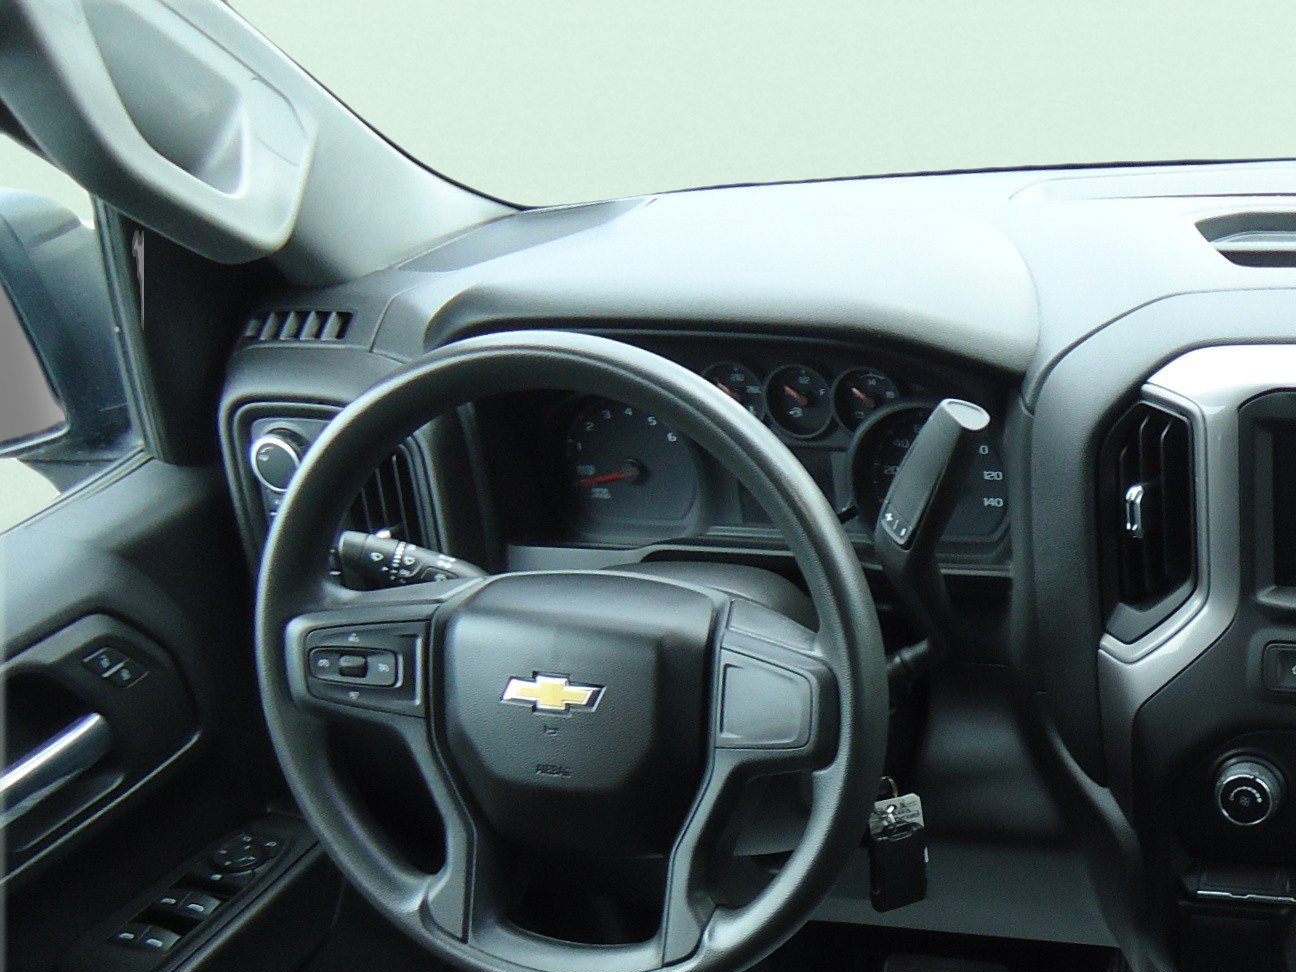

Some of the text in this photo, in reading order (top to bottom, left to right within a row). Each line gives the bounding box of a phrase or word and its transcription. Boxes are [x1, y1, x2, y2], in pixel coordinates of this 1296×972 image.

[624, 407, 633, 416] 4
[586, 421, 595, 431] 2
[647, 416, 657, 426] 5
[667, 432, 677, 442] 6
[983, 471, 1003, 481] 120
[983, 498, 1004, 507] 140
